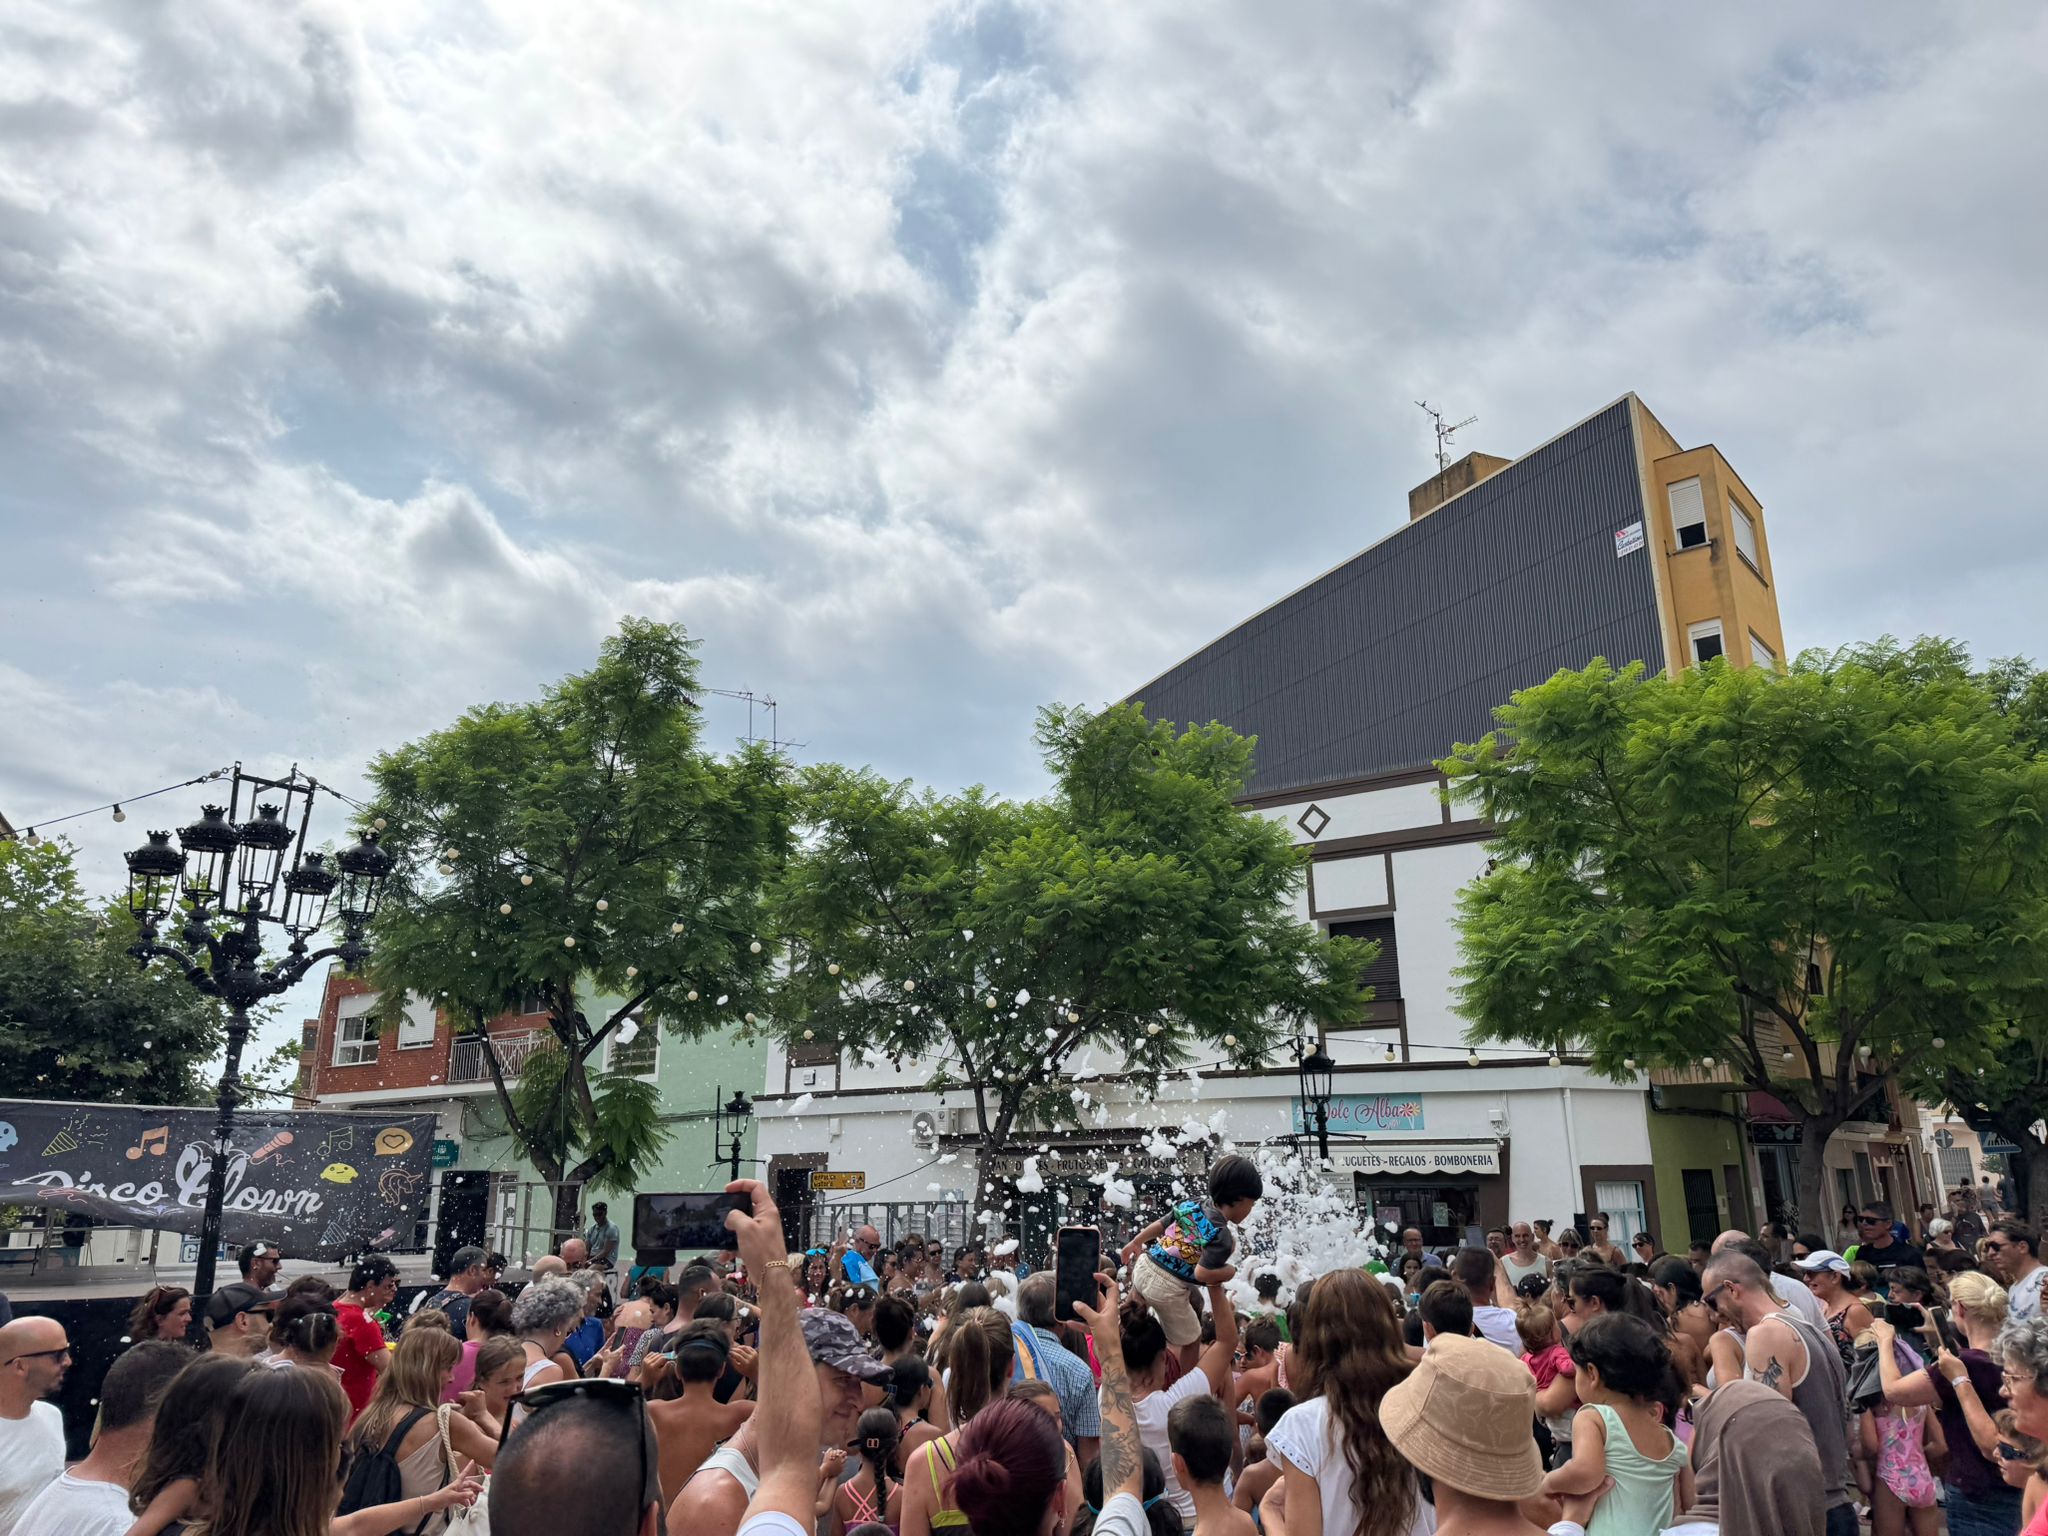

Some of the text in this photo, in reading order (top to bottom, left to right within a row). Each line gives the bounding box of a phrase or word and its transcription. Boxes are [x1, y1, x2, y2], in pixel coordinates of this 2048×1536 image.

[1354, 1096, 1401, 1128] Alba
[1057, 1159, 1092, 1171] FRUTOS
[1342, 1155, 1382, 1167] UGUETES
[1388, 1155, 1427, 1167] REGALOS
[1434, 1154, 1494, 1167] BOMBONERIA
[176, 1143, 324, 1214] Clown
